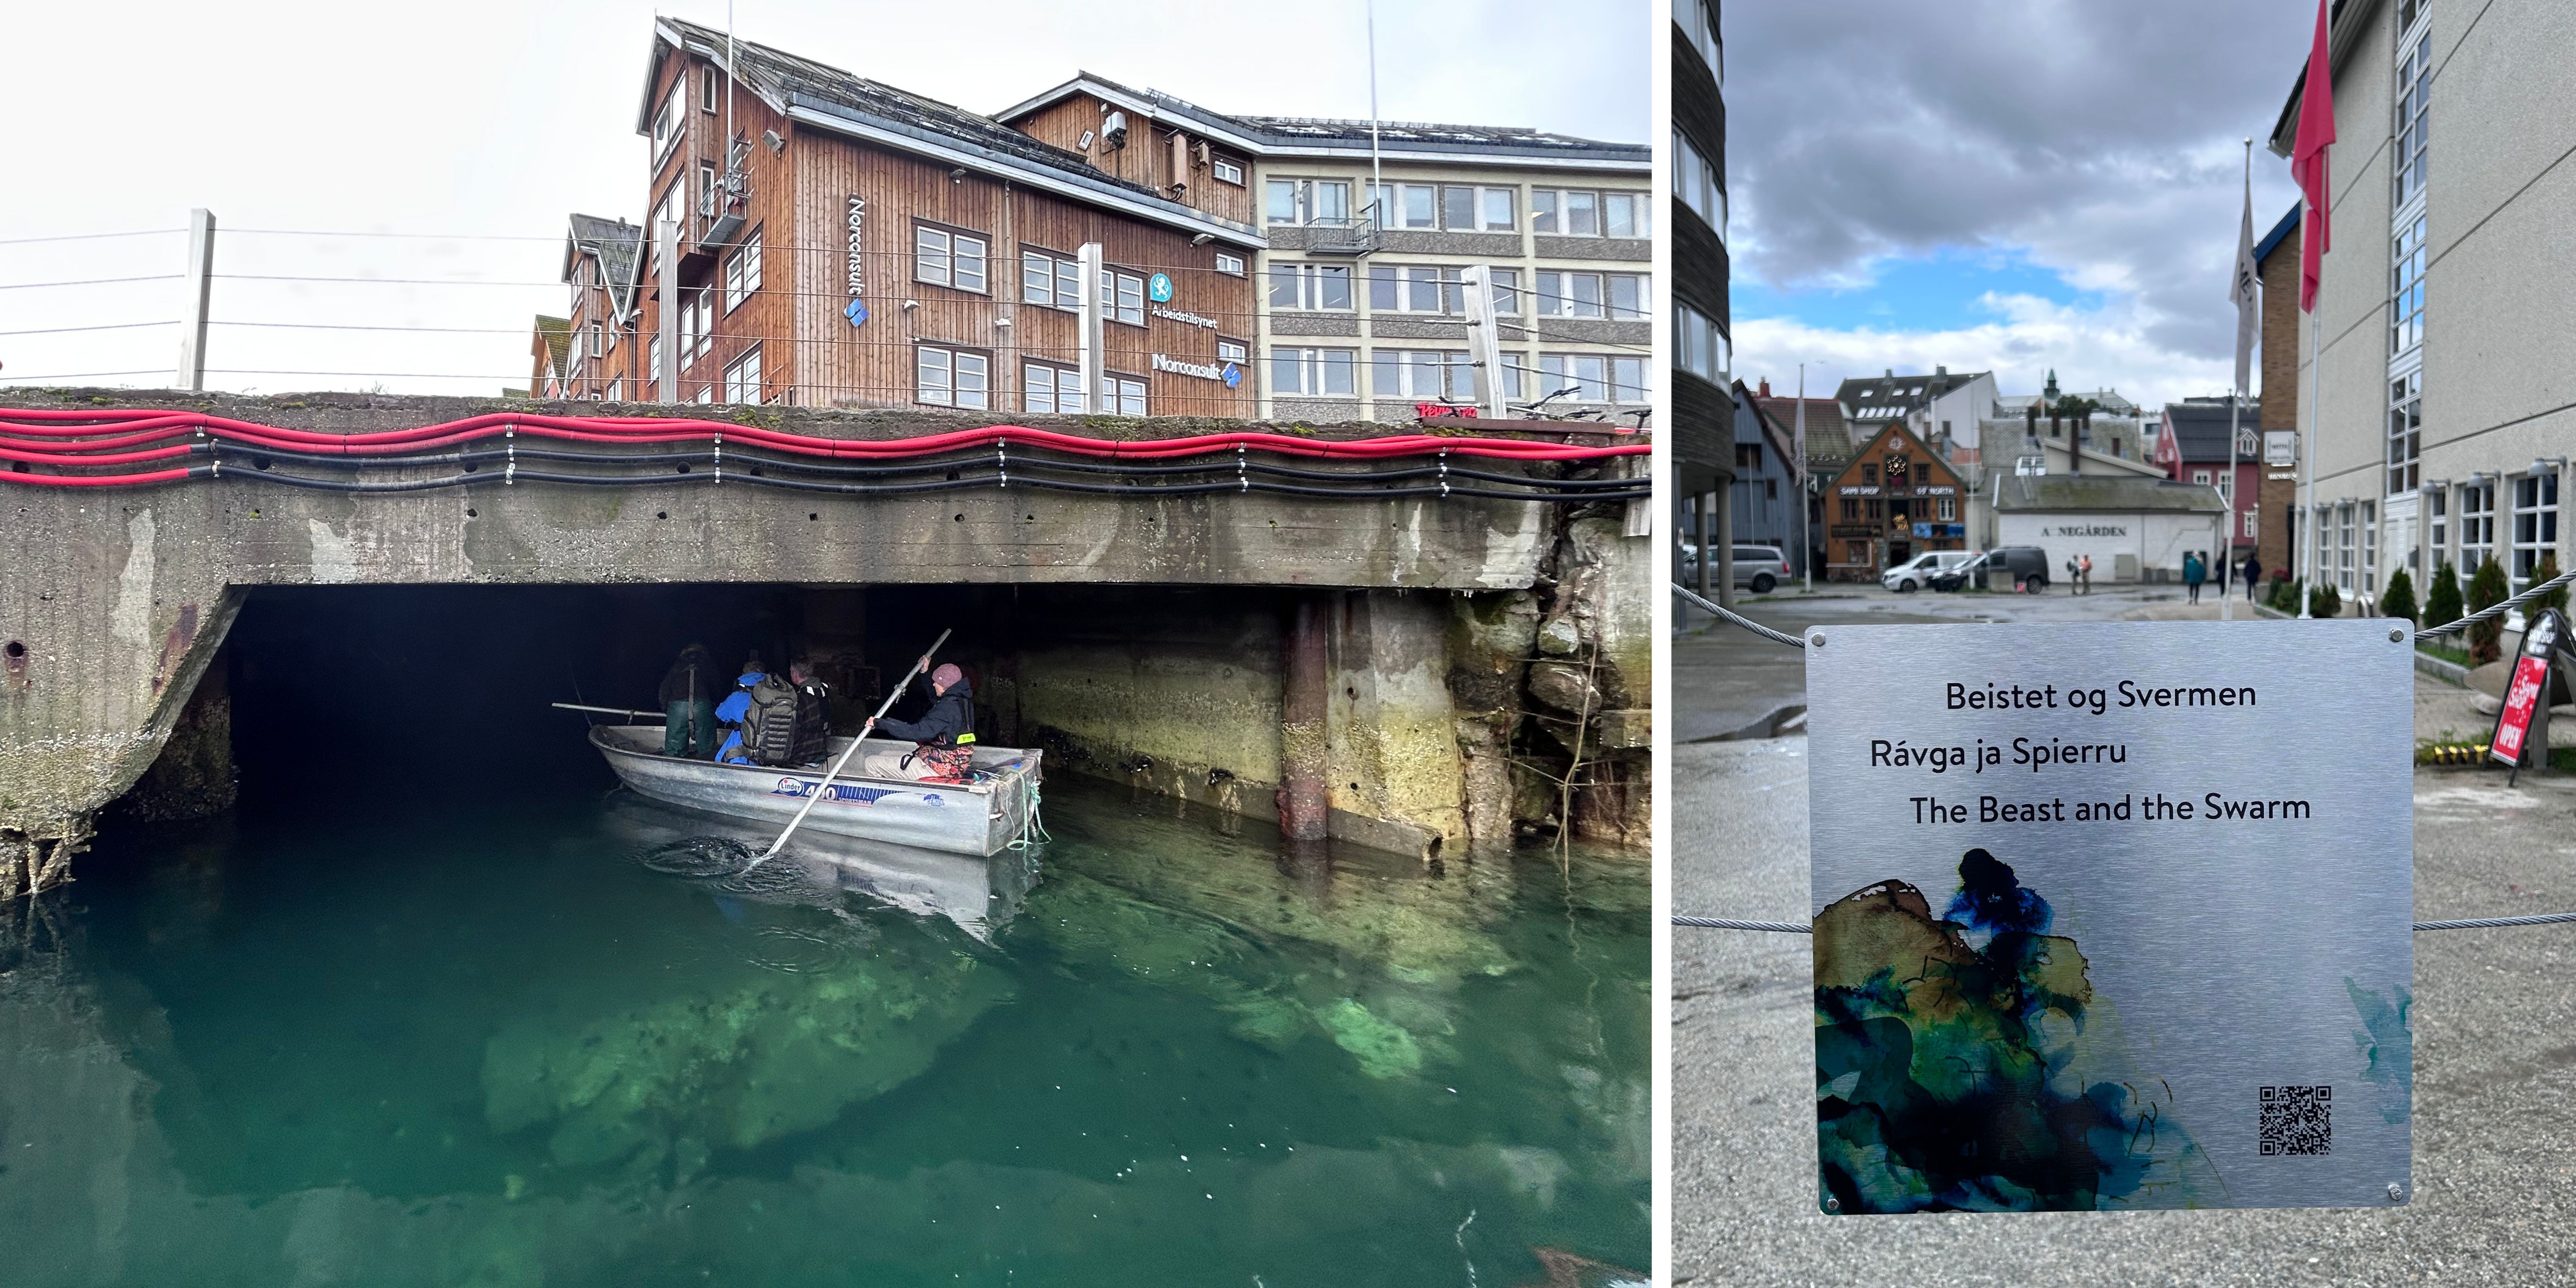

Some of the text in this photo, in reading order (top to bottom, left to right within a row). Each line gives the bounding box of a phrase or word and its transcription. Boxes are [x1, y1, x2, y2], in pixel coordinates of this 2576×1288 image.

[849, 198, 865, 296] Norconsult
[1152, 304, 1218, 329] Arbeidstilsynet
[1152, 353, 1221, 380] Norconsult
[1859, 486, 1879, 495] SHOP
[1947, 680, 2255, 715] Beistet og Svermen
[2499, 722, 2522, 751] OPEN
[1872, 737, 2125, 774] Rávga ja Spierru
[781, 780, 801, 791] Linder
[1910, 793, 2310, 824] The Beast and the Swarm
